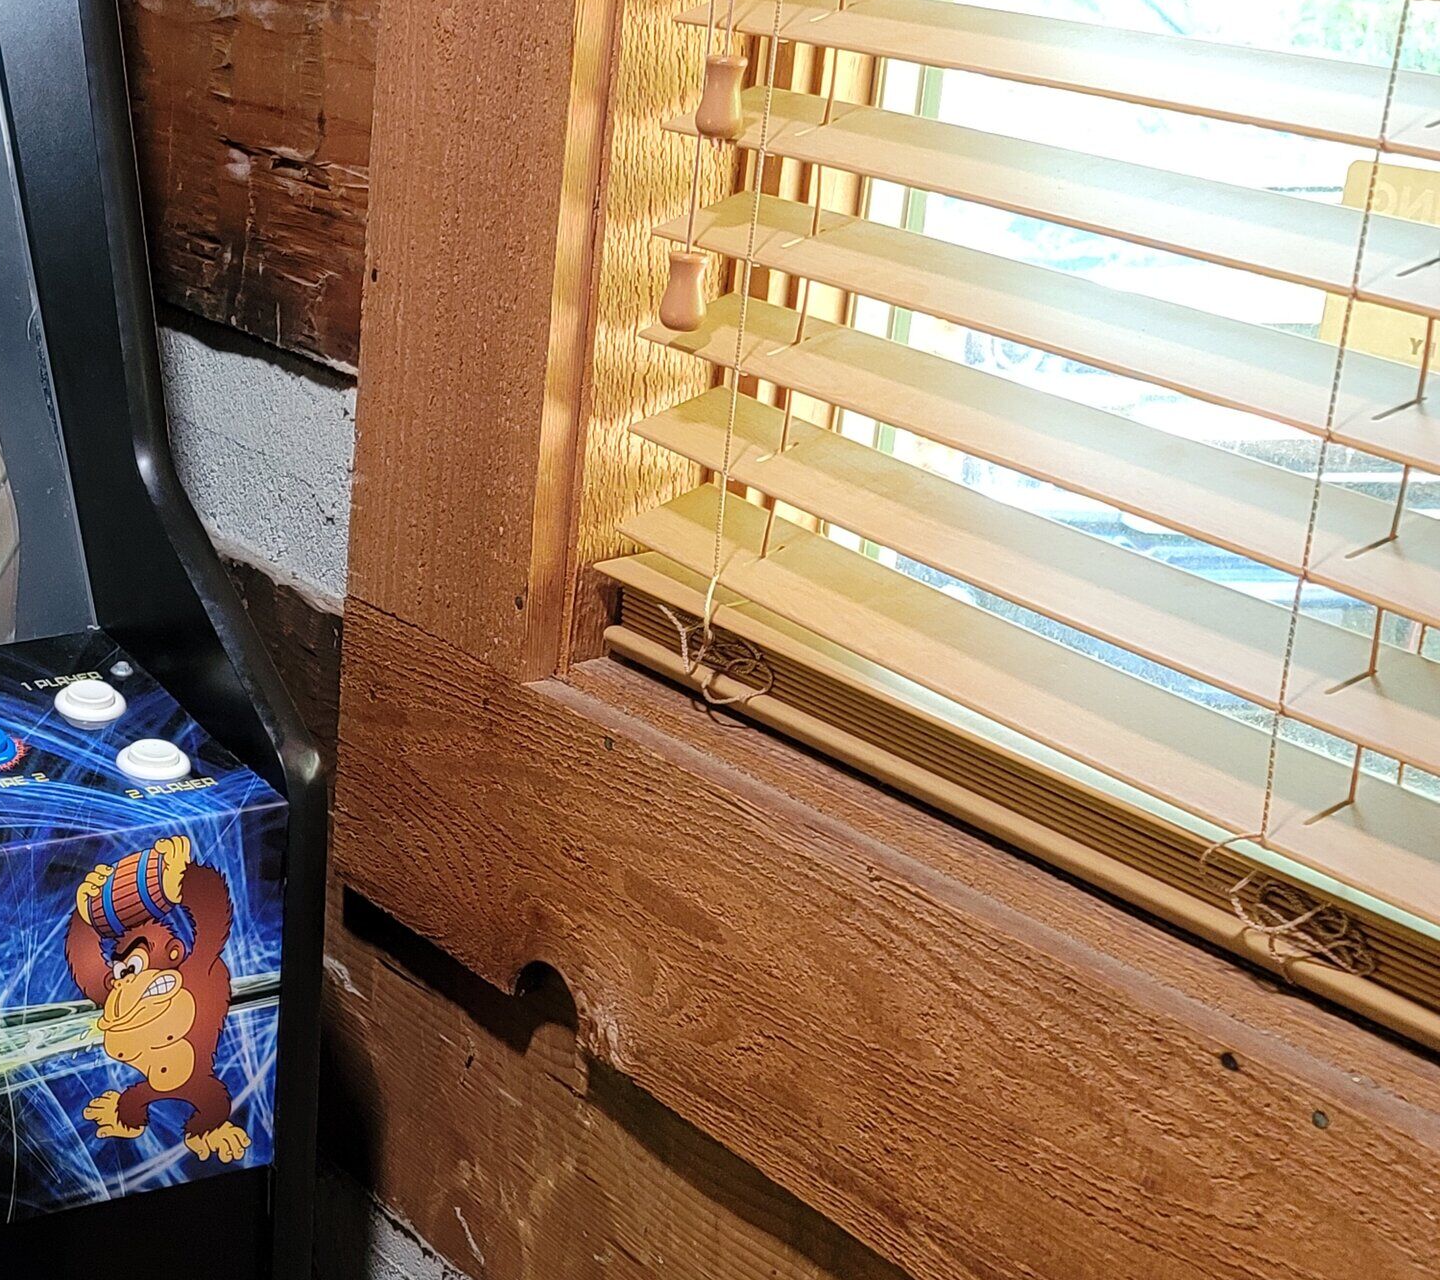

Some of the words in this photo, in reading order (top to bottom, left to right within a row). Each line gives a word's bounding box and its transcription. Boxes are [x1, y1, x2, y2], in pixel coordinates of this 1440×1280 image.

[20, 681, 33, 691] 1
[31, 772, 50, 783] 2
[125, 789, 144, 799] 2
[145, 777, 220, 796] PLAYER
